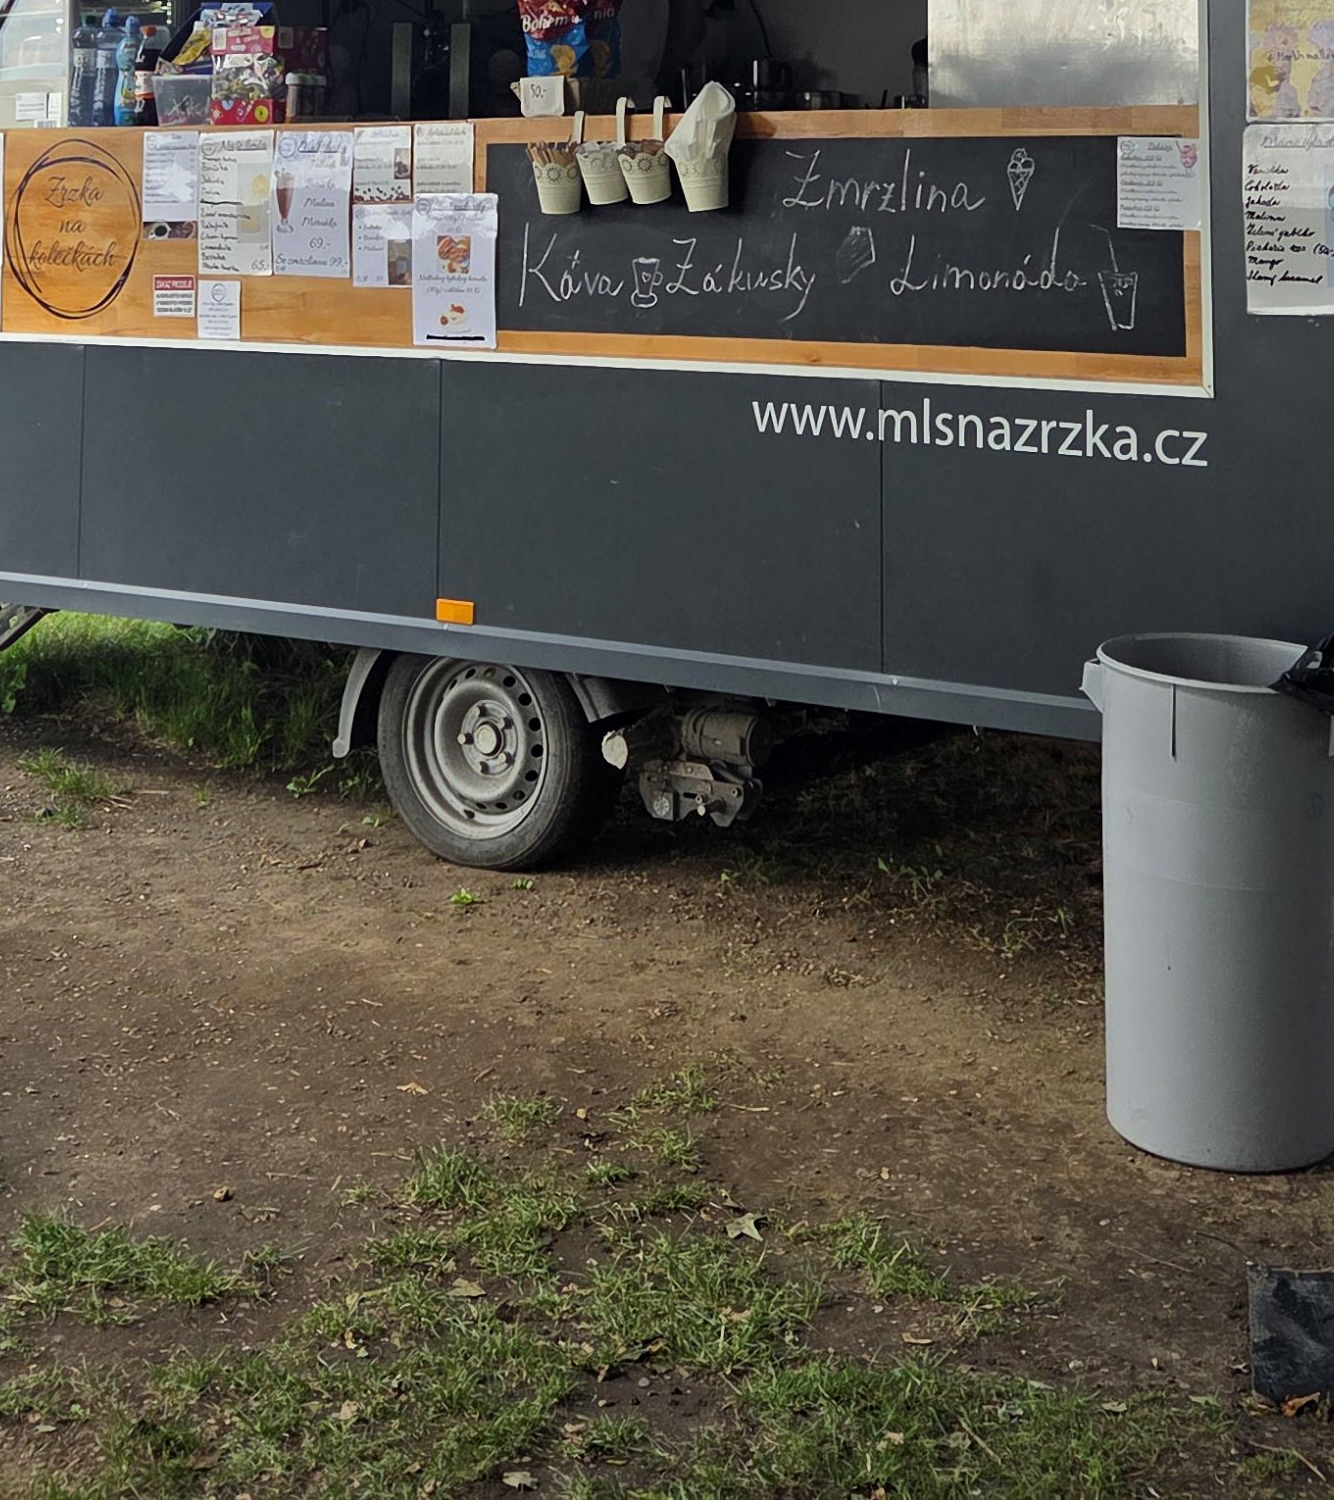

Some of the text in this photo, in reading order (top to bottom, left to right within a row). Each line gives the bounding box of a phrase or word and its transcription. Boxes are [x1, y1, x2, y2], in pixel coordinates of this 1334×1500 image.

[44, 176, 104, 208] Zrzka
[782, 147, 986, 213] Zmrzlina
[59, 220, 85, 233] na
[25, 240, 120, 273] kolečkách
[518, 222, 624, 307] Káva
[666, 232, 816, 322] Zákusky
[752, 397, 1209, 467] www.mlsnazrzka.cz
